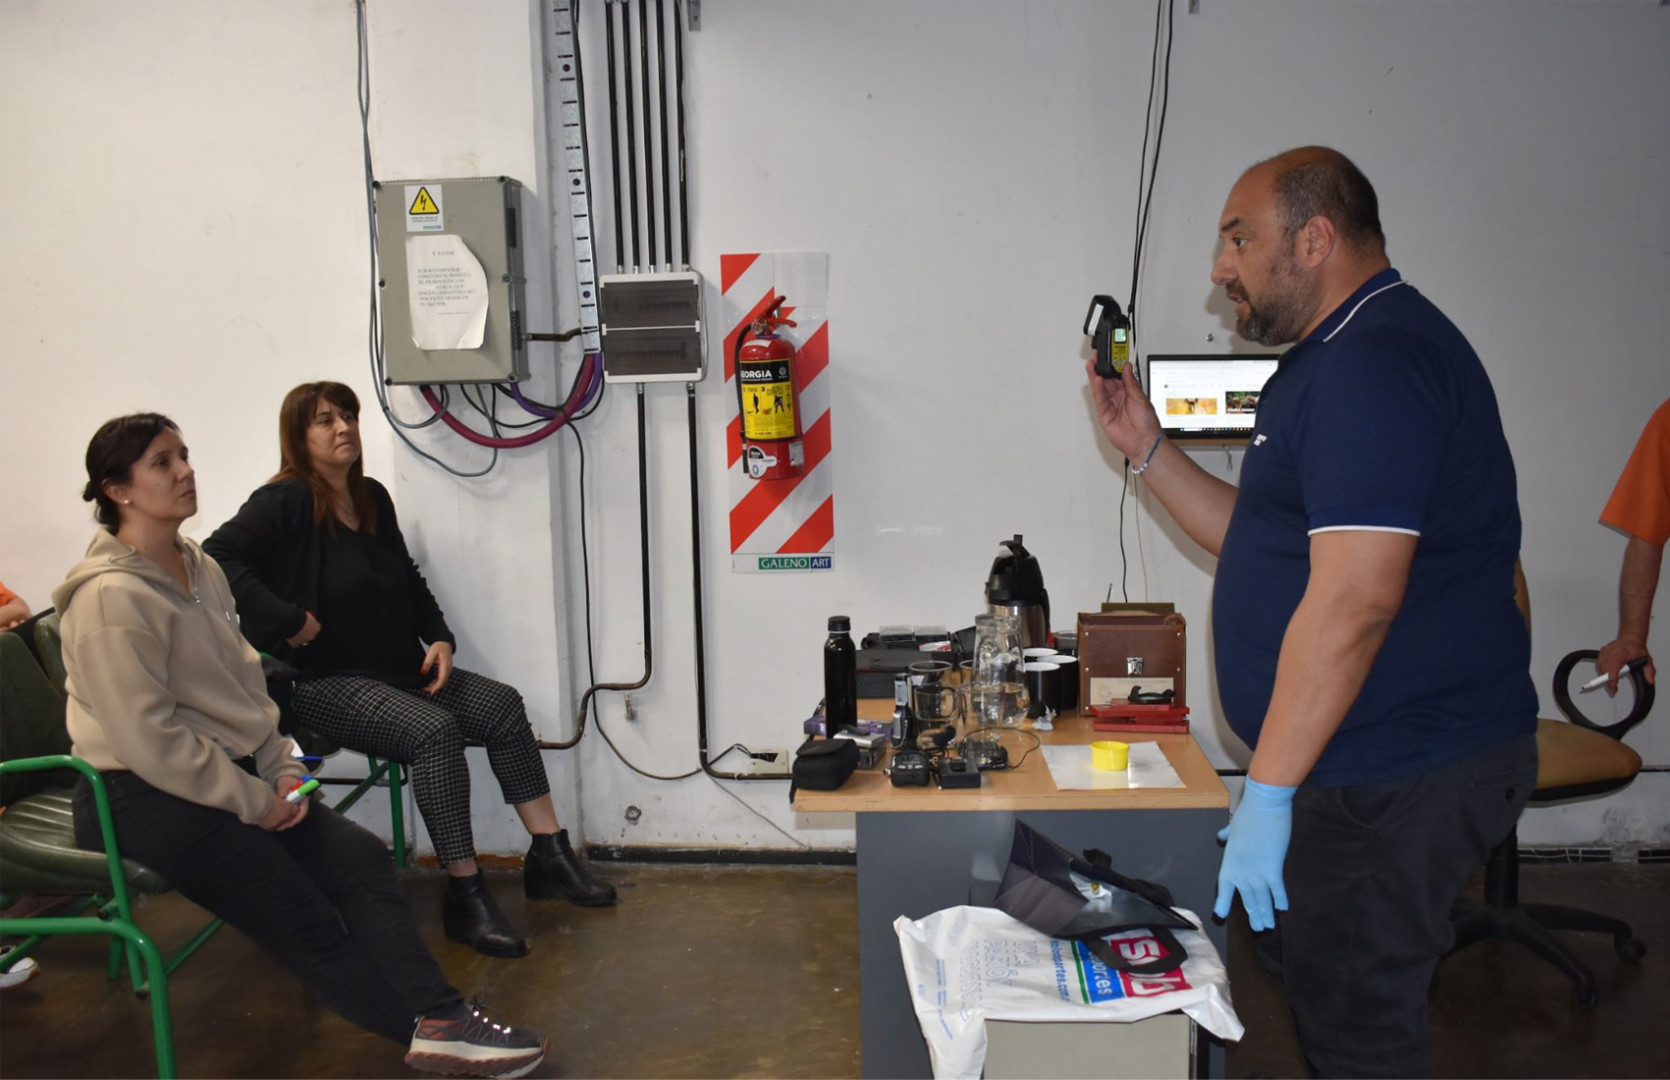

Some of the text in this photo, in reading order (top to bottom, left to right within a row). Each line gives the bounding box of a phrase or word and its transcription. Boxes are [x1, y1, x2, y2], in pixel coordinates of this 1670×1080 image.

[740, 370, 773, 379] EORGIA
[761, 558, 830, 569] GALENO ART
[1088, 951, 1114, 996] portes
